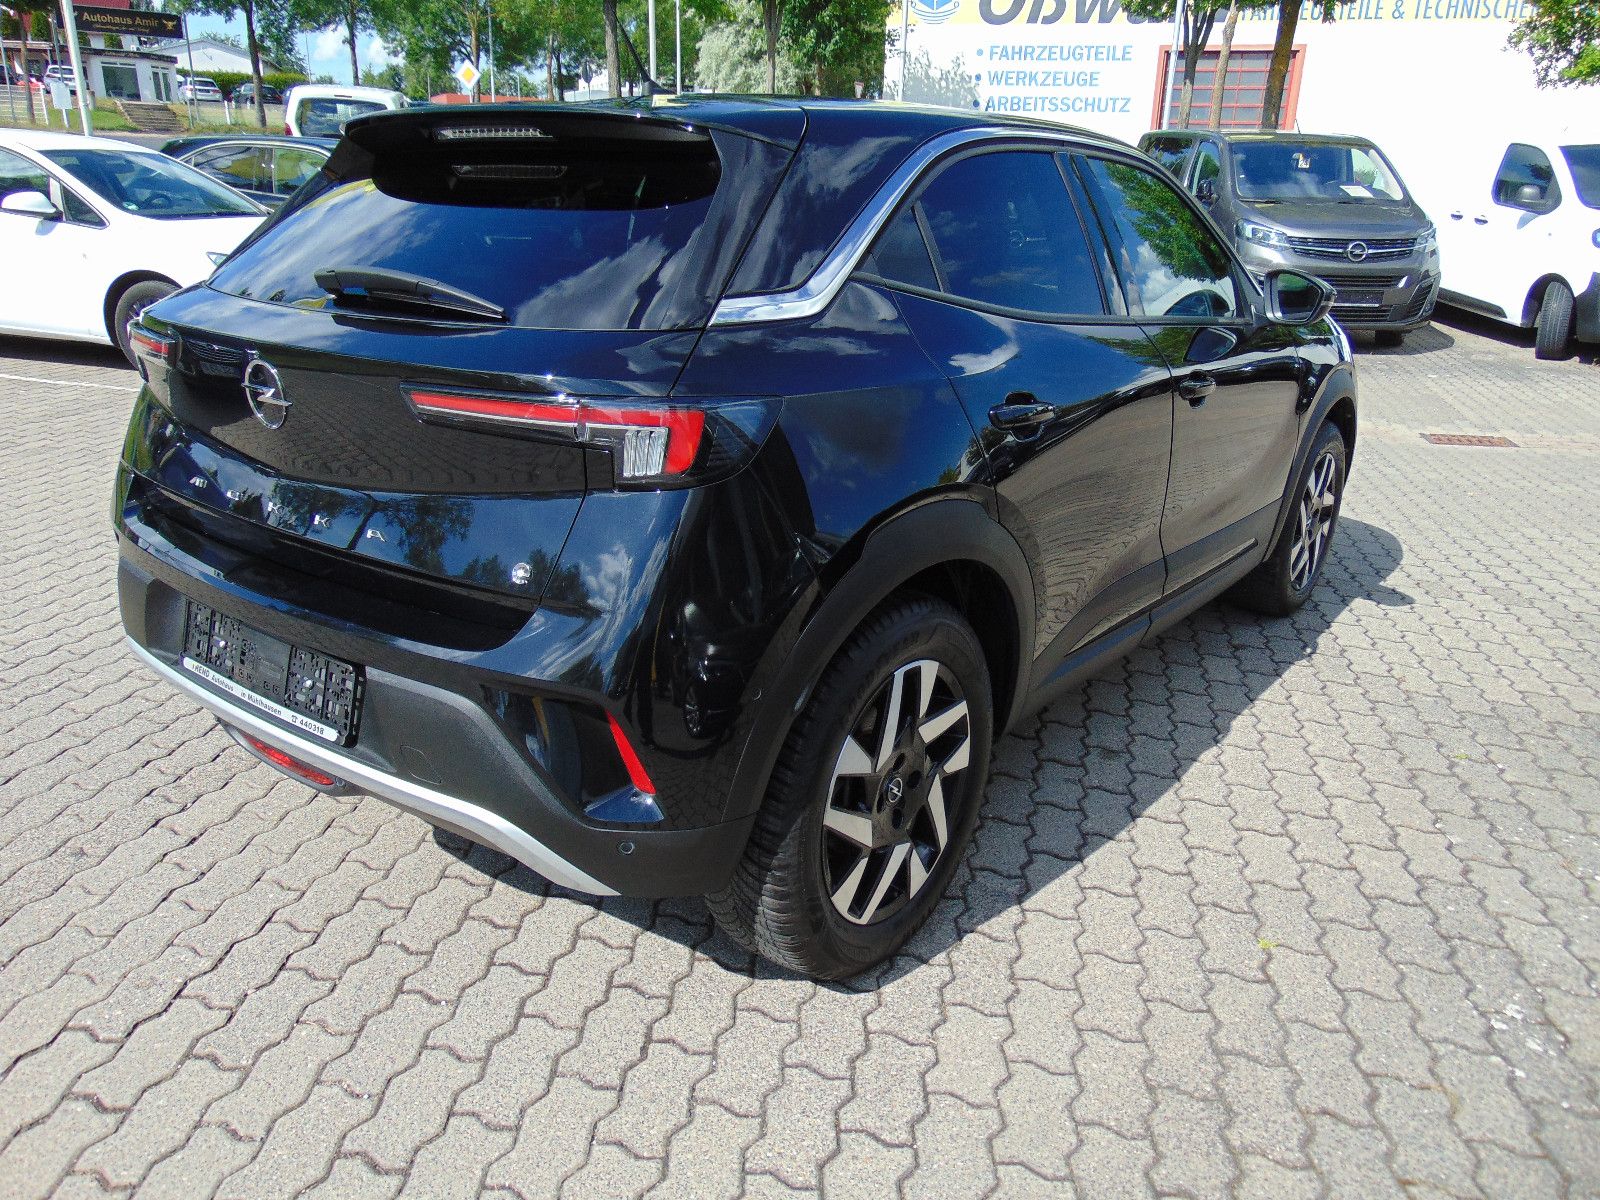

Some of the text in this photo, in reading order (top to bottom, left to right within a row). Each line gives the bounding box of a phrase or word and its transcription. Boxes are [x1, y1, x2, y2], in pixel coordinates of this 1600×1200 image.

[1392, 0, 1404, 19] &
[83, 12, 159, 27] Autohaus Amir
[989, 45, 1133, 62] FAHRZEUGTEILE
[988, 71, 1100, 87] WERKZEUGE
[985, 96, 1131, 113] ARBEITSSCHUTZ
[189, 476, 387, 542] MOKKA
[247, 693, 282, 716] Mühlhausen
[299, 718, 325, 735] 440318
